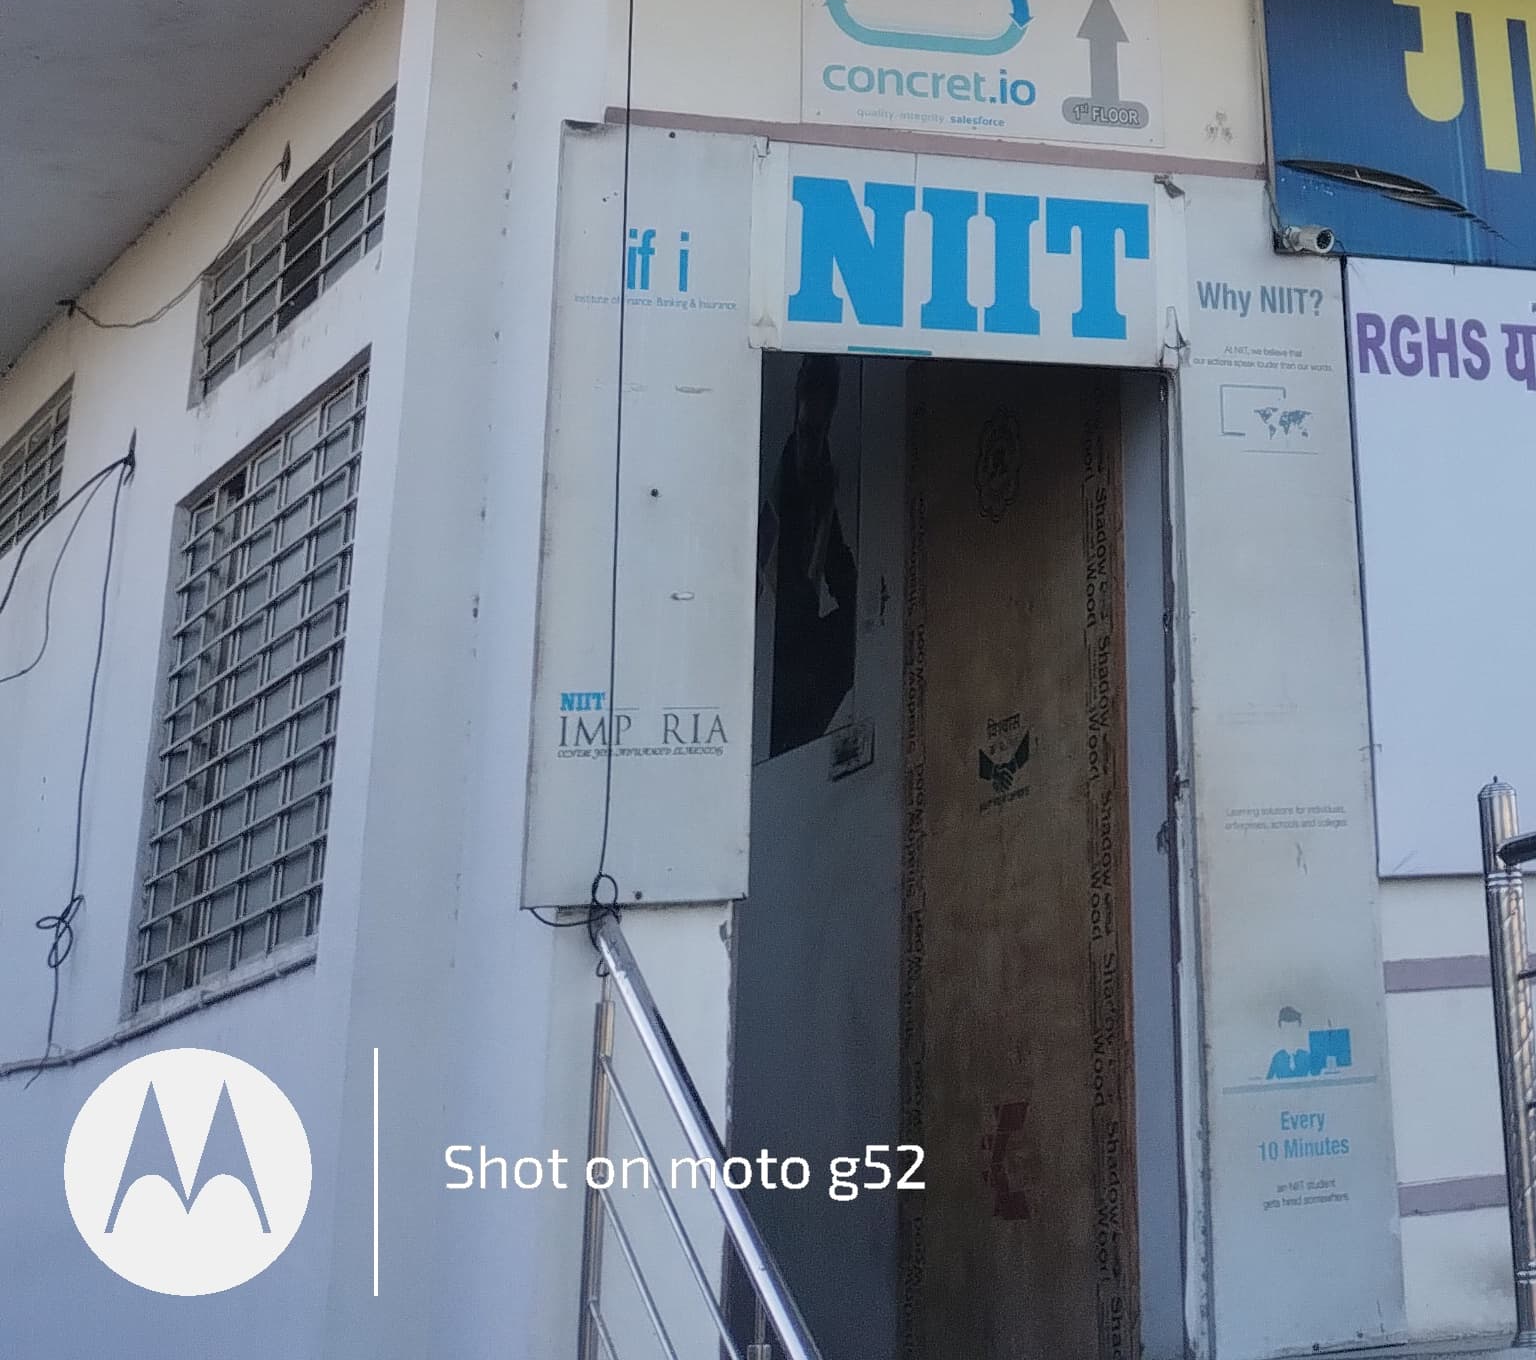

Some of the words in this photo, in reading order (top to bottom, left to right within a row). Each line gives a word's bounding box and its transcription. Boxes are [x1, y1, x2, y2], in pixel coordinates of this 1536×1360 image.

[821, 63, 1037, 107] concret.io
[950, 113, 1006, 128] salesforce
[1091, 107, 1140, 126] FLOOR
[787, 175, 1149, 341] NIIT
[1196, 280, 1252, 318] Why
[1259, 284, 1324, 317] NIIT?
[1355, 311, 1492, 381] RGHS
[559, 691, 606, 712] NIIT
[1280, 1110, 1325, 1132] Every
[1258, 1140, 1279, 1161] 10
[1283, 1136, 1350, 1160] Minutes
